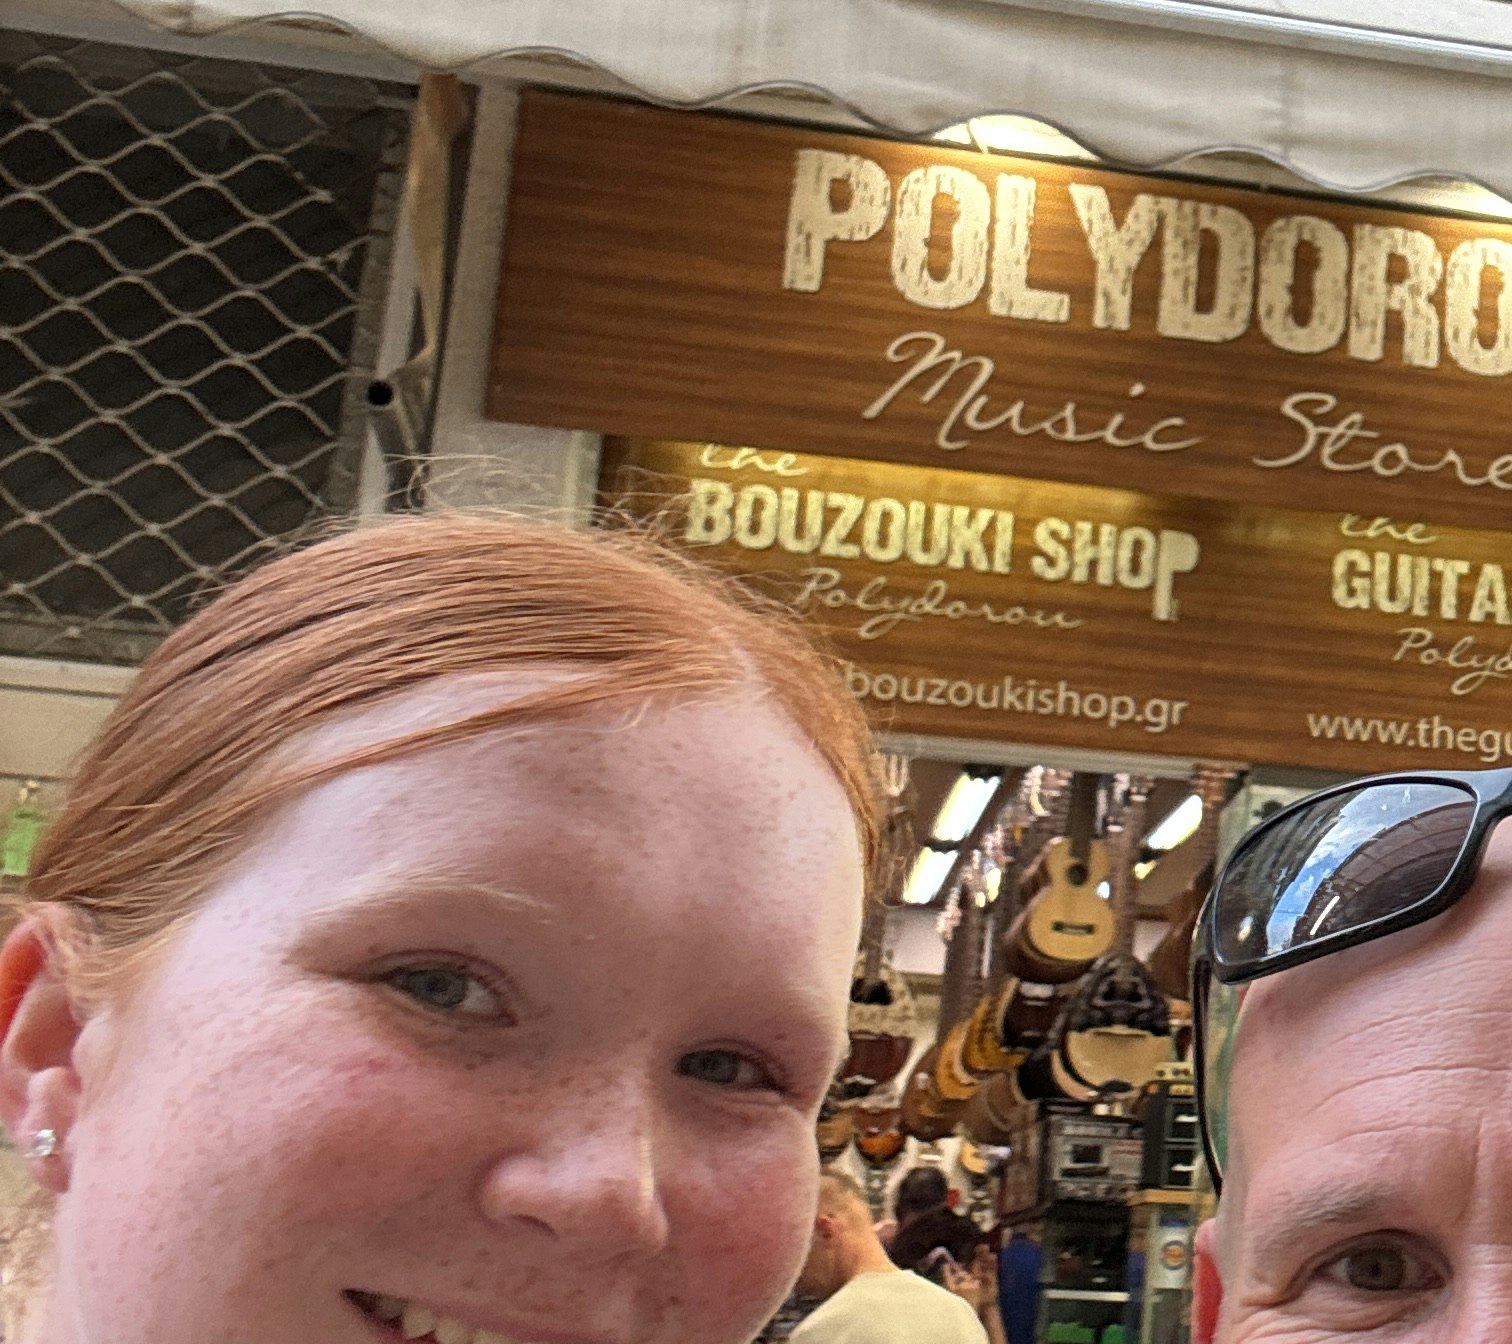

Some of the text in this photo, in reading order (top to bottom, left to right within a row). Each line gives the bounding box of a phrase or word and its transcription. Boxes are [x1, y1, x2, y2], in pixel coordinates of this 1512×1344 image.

[861, 330, 1205, 450] Music
[684, 478, 1200, 622] BOUZOUKI SHOP
[796, 566, 1086, 640] Polydorou
[846, 660, 1190, 734] bouzoukishop.gr
